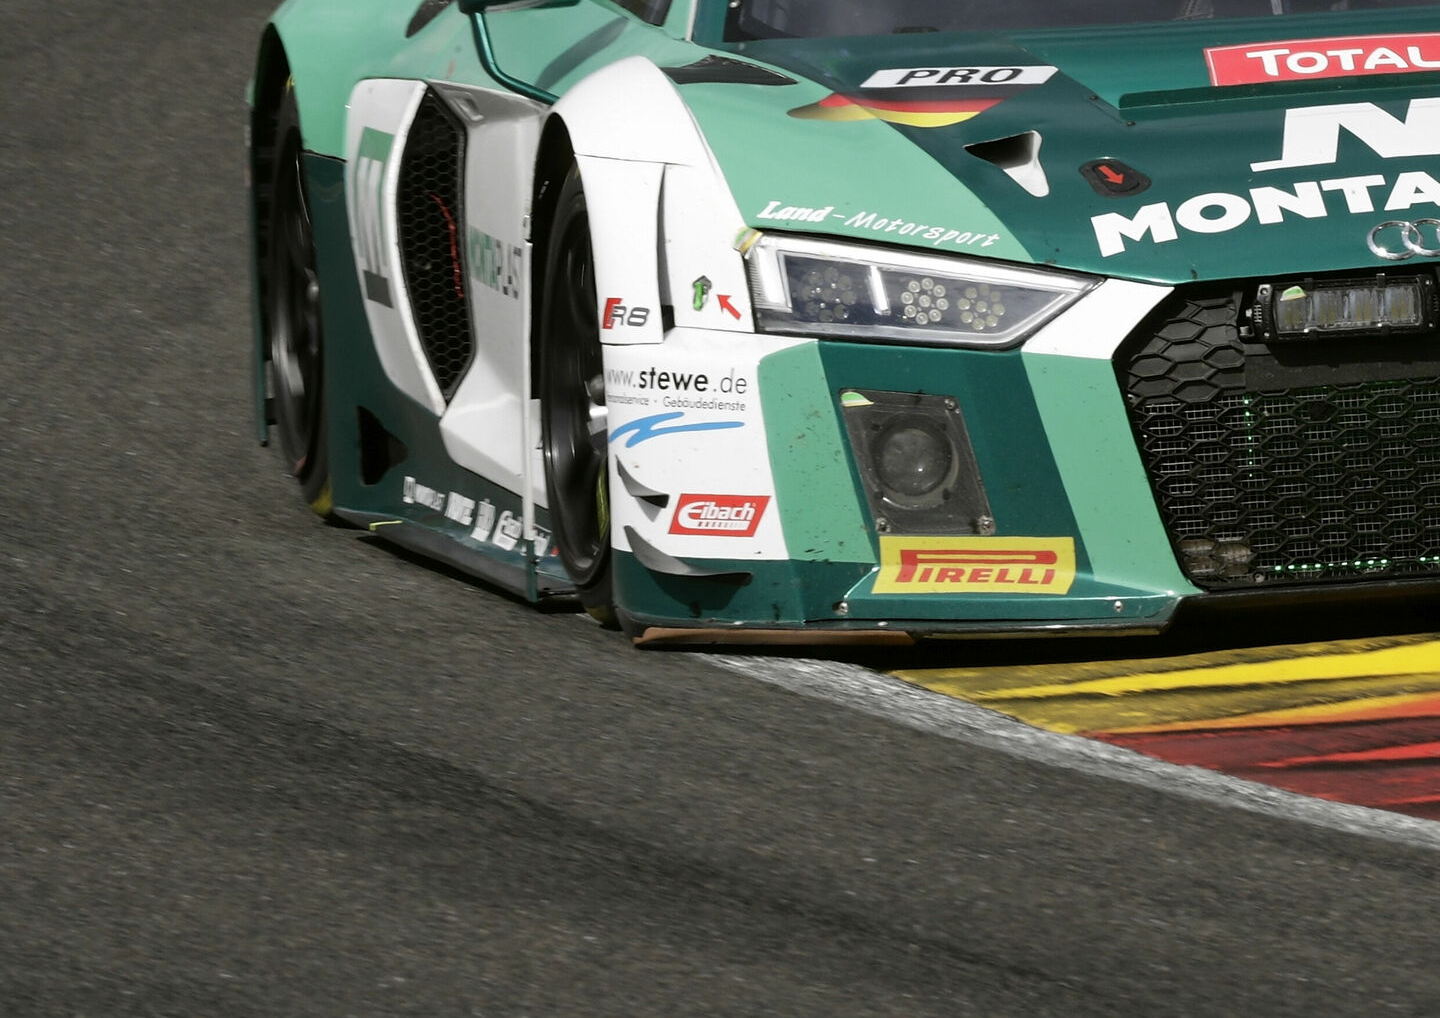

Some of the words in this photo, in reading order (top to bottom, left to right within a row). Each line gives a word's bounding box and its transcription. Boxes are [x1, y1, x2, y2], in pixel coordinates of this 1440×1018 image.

[906, 67, 1024, 85] PRO
[606, 301, 651, 327] R8
[678, 501, 756, 531] Eibach
[895, 549, 1057, 585] PIRELLI
